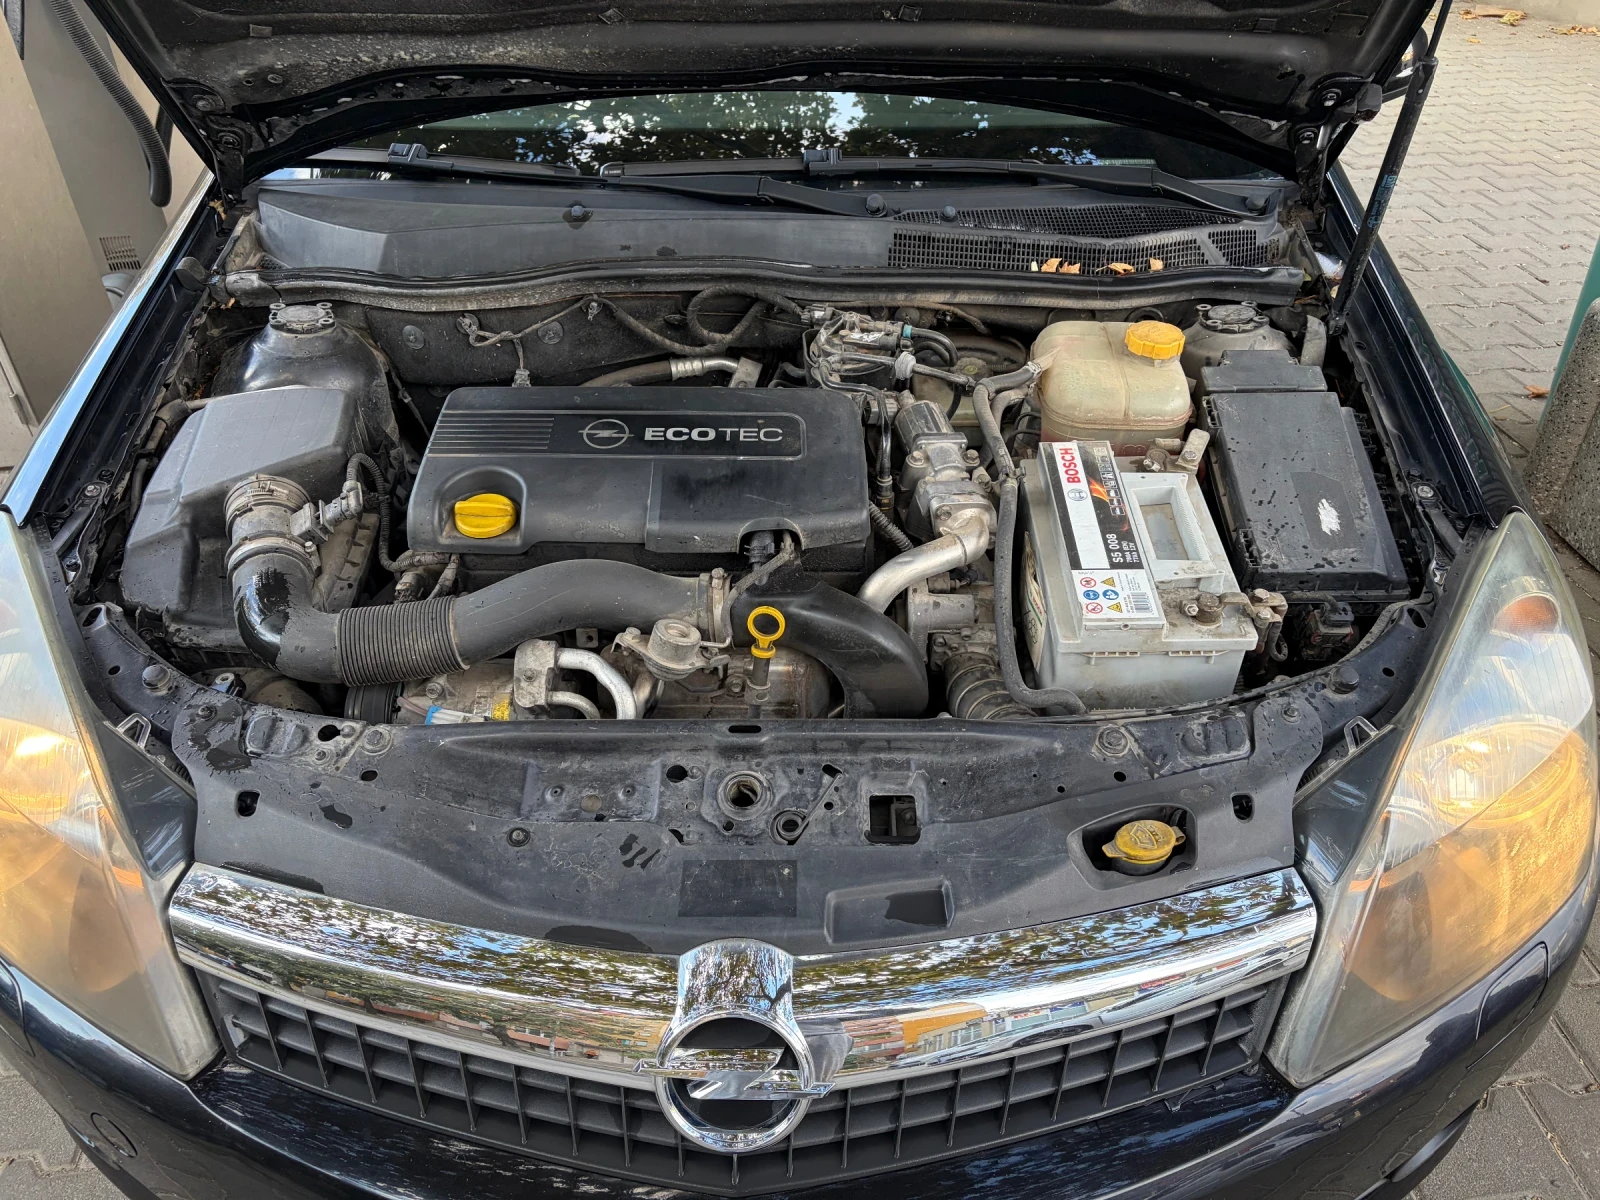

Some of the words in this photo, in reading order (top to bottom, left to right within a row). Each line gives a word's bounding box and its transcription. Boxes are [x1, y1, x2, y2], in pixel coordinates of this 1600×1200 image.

[644, 427, 783, 442] ECOTEC
[1059, 448, 1081, 484] BOSCH
[1106, 533, 1120, 550] 008
[1111, 551, 1124, 563] S5
